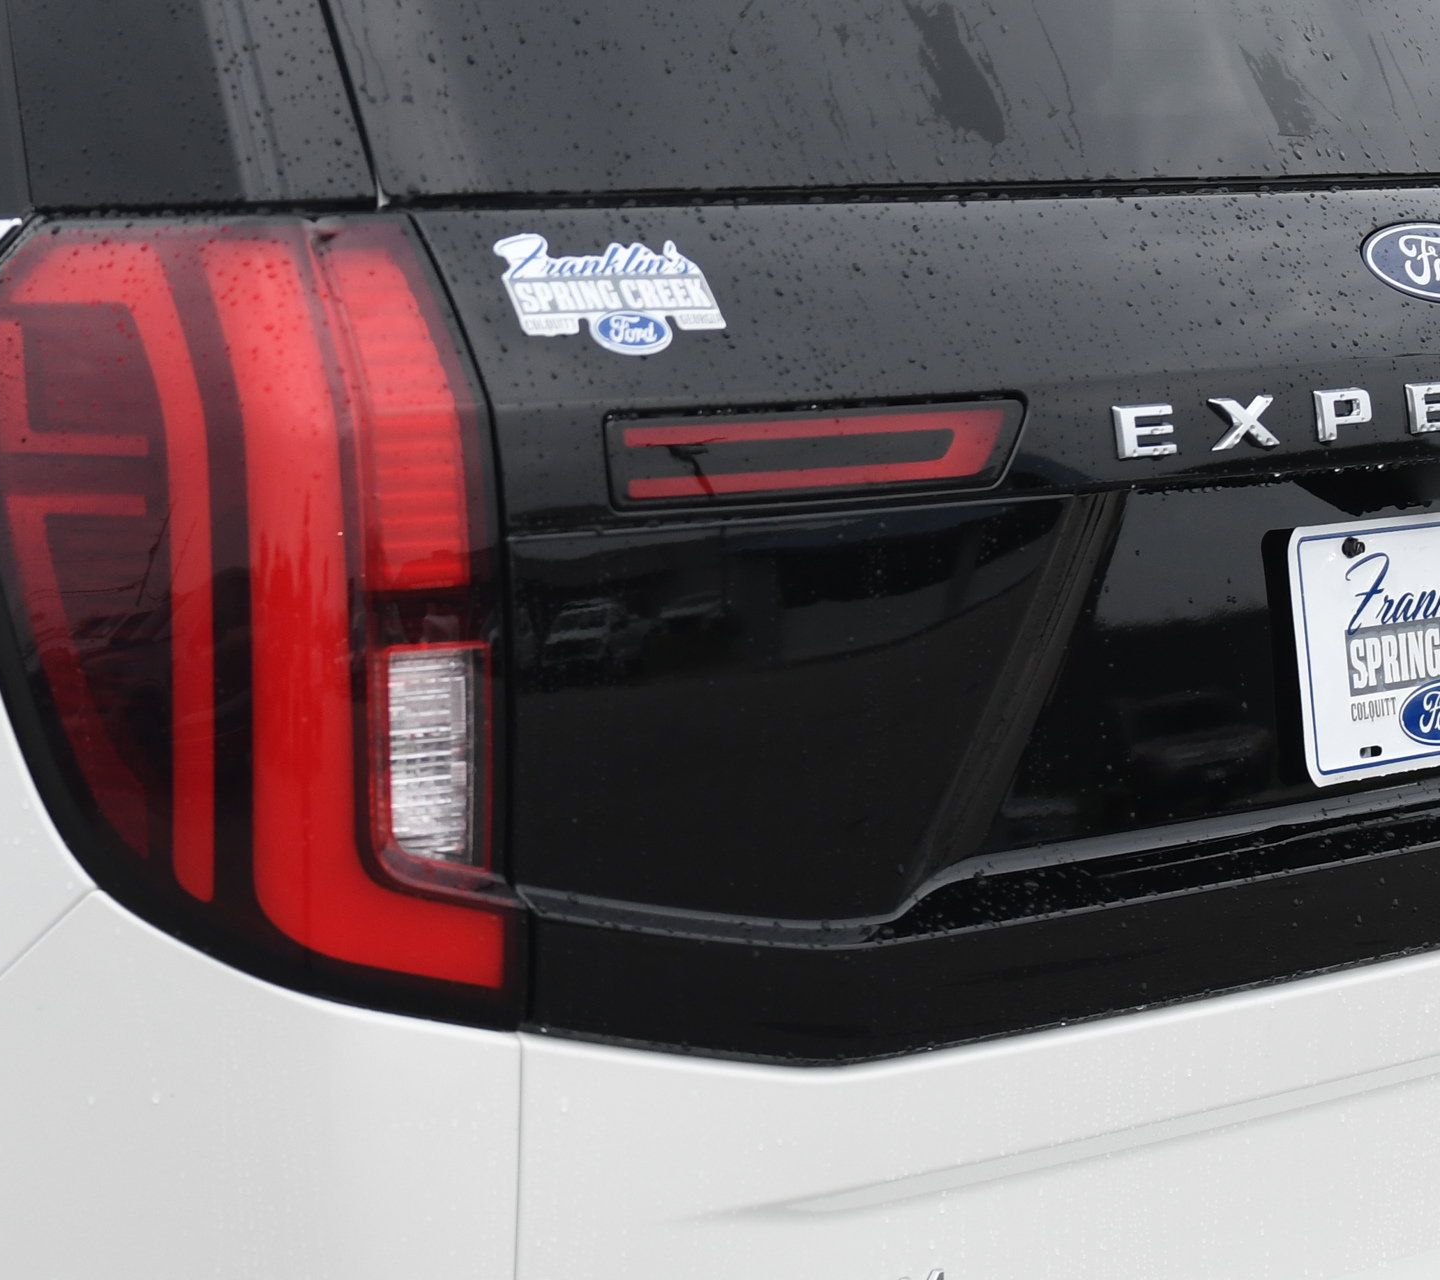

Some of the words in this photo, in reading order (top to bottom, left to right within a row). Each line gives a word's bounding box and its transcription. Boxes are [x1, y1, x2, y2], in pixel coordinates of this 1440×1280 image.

[496, 236, 690, 279] Franklin's
[514, 279, 622, 313] SPRING
[620, 278, 712, 310] CREEK
[608, 316, 658, 344] Ford
[1350, 696, 1397, 722] COLQUITT
